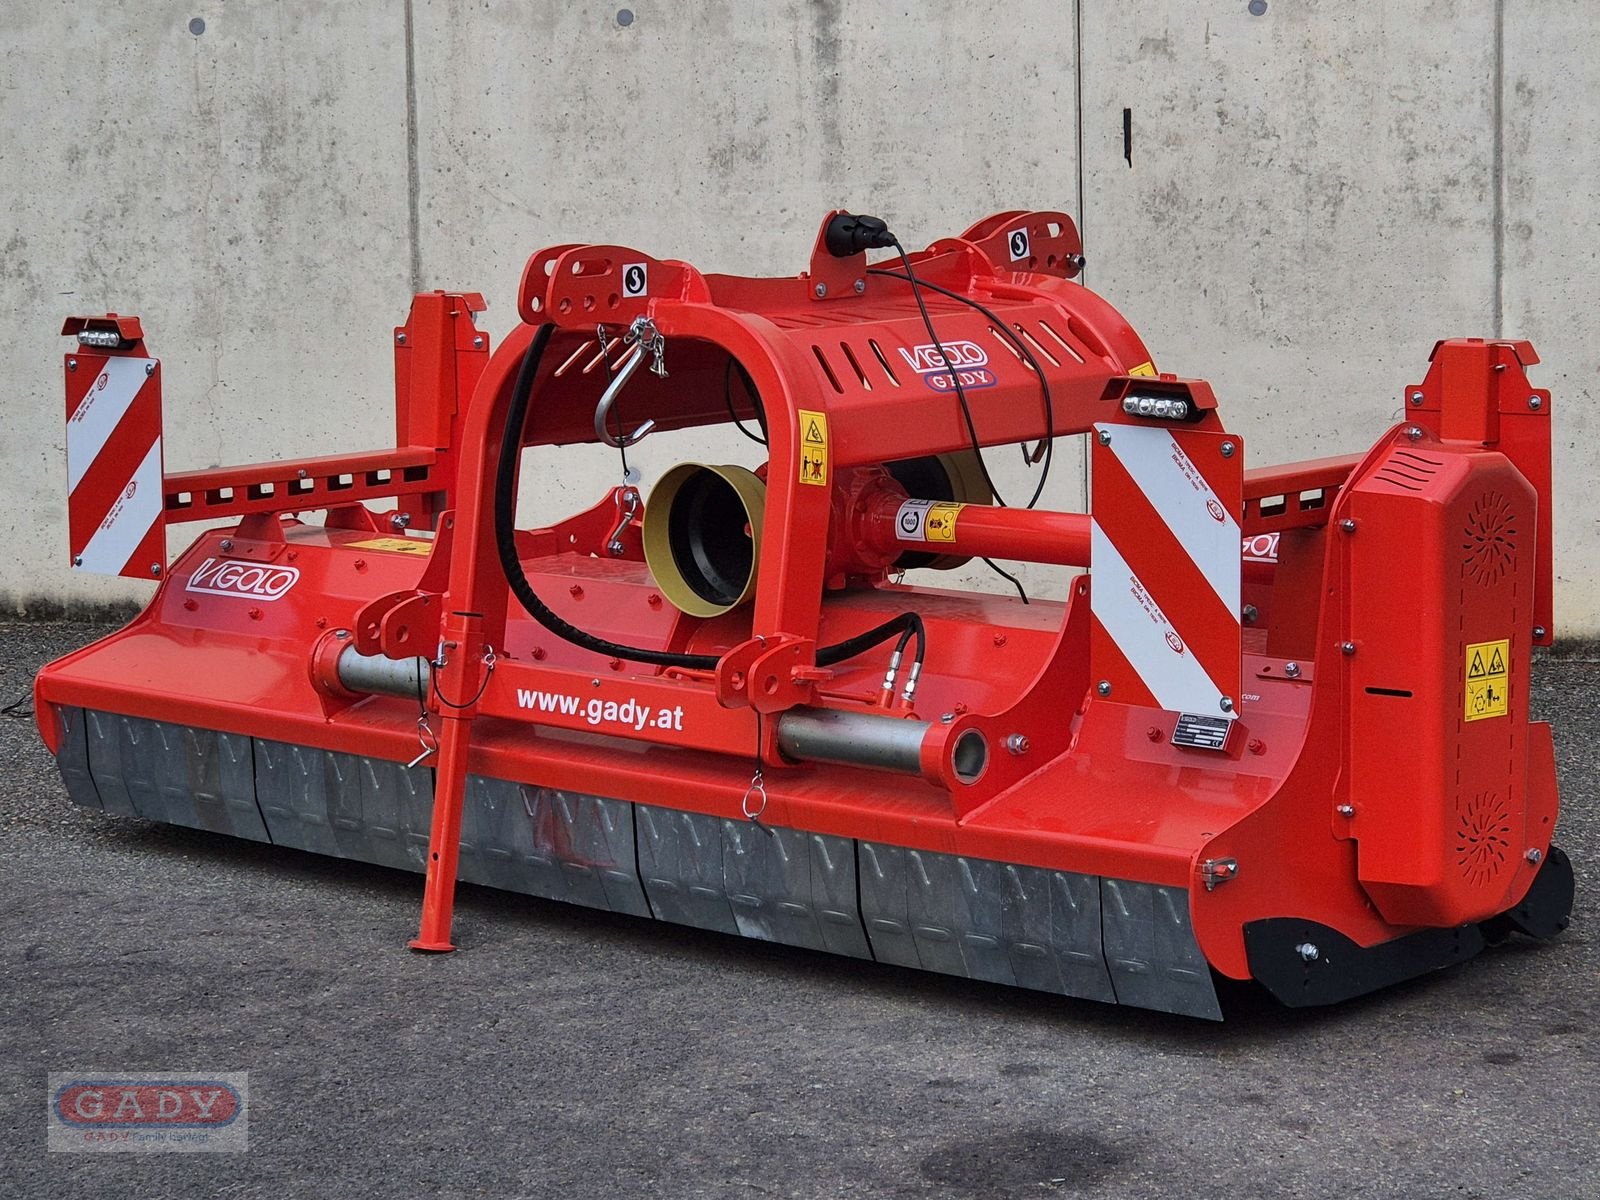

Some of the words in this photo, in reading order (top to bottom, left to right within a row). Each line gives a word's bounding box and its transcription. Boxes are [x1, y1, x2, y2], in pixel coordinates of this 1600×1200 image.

[898, 342, 986, 371] VIGOLO
[187, 558, 297, 598] VIGOLO
[517, 688, 684, 731] www.gady.at
